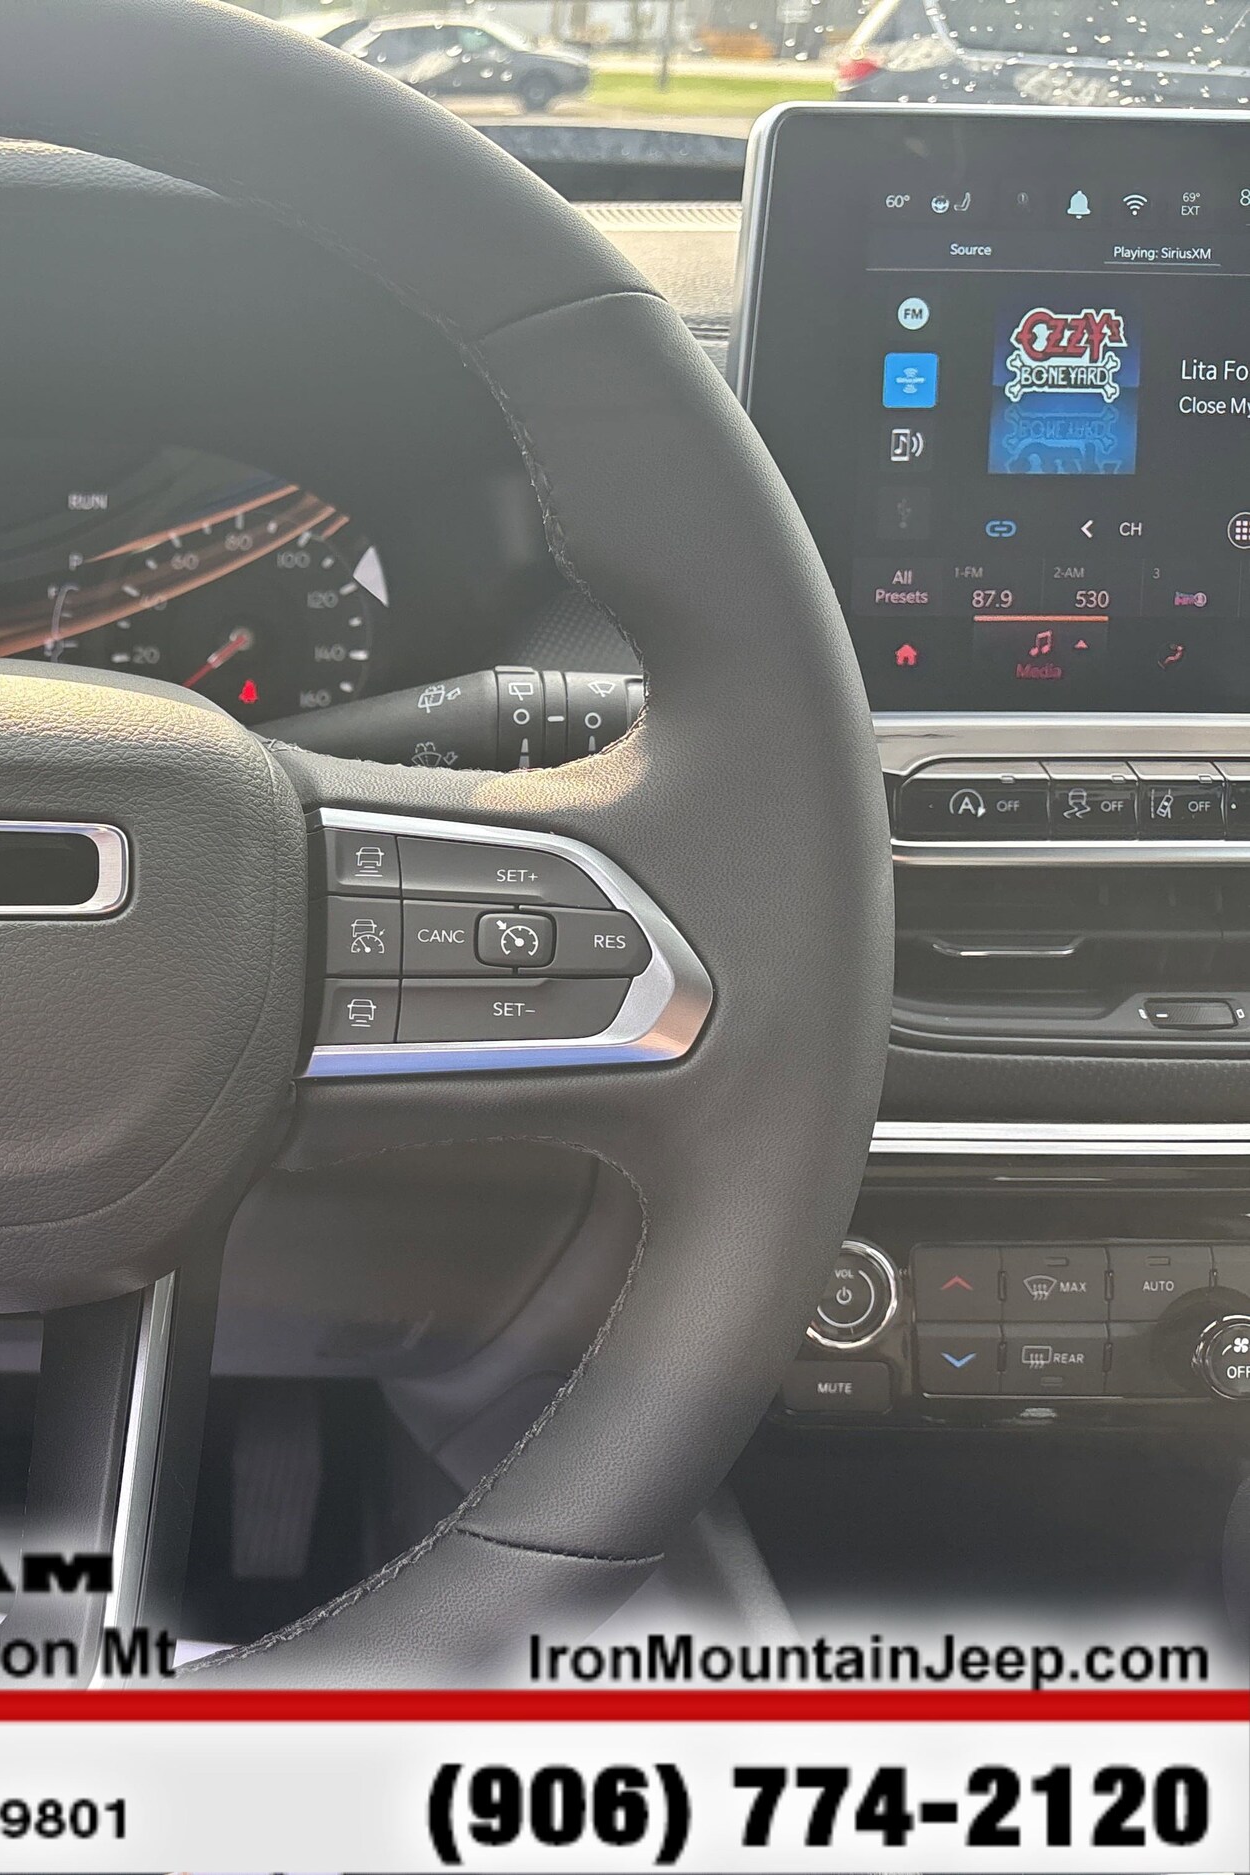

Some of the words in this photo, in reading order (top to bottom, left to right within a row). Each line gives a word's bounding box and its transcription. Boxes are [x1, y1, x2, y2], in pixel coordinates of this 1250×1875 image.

[1181, 205, 1200, 216] EXT
[950, 242, 992, 257] Source
[1113, 246, 1159, 261] Playing:
[1161, 247, 1211, 260] SiriusXM
[903, 308, 923, 320] FM
[1182, 359, 1217, 381] Lita
[1179, 396, 1227, 414] Close
[1119, 522, 1142, 537] CH
[892, 570, 912, 585] All
[954, 566, 984, 579] 1-FM
[1053, 566, 1085, 579] 2-AM
[1152, 567, 1161, 579] 3
[875, 589, 929, 604] Presets
[971, 589, 1013, 608] 87.9
[1074, 590, 1110, 608] 530
[1016, 663, 1063, 680] Media
[996, 800, 1020, 813] OFF
[1100, 800, 1124, 813] OFF
[1188, 801, 1211, 813] OFF
[496, 868, 539, 883] SET+
[417, 929, 466, 944] CANC
[594, 935, 627, 950] RES
[834, 1268, 854, 1279] VOL
[1059, 1281, 1087, 1293] MAX
[1142, 1280, 1175, 1293] AUTO
[1053, 1353, 1085, 1365] REAR
[816, 1382, 853, 1395] MUTE
